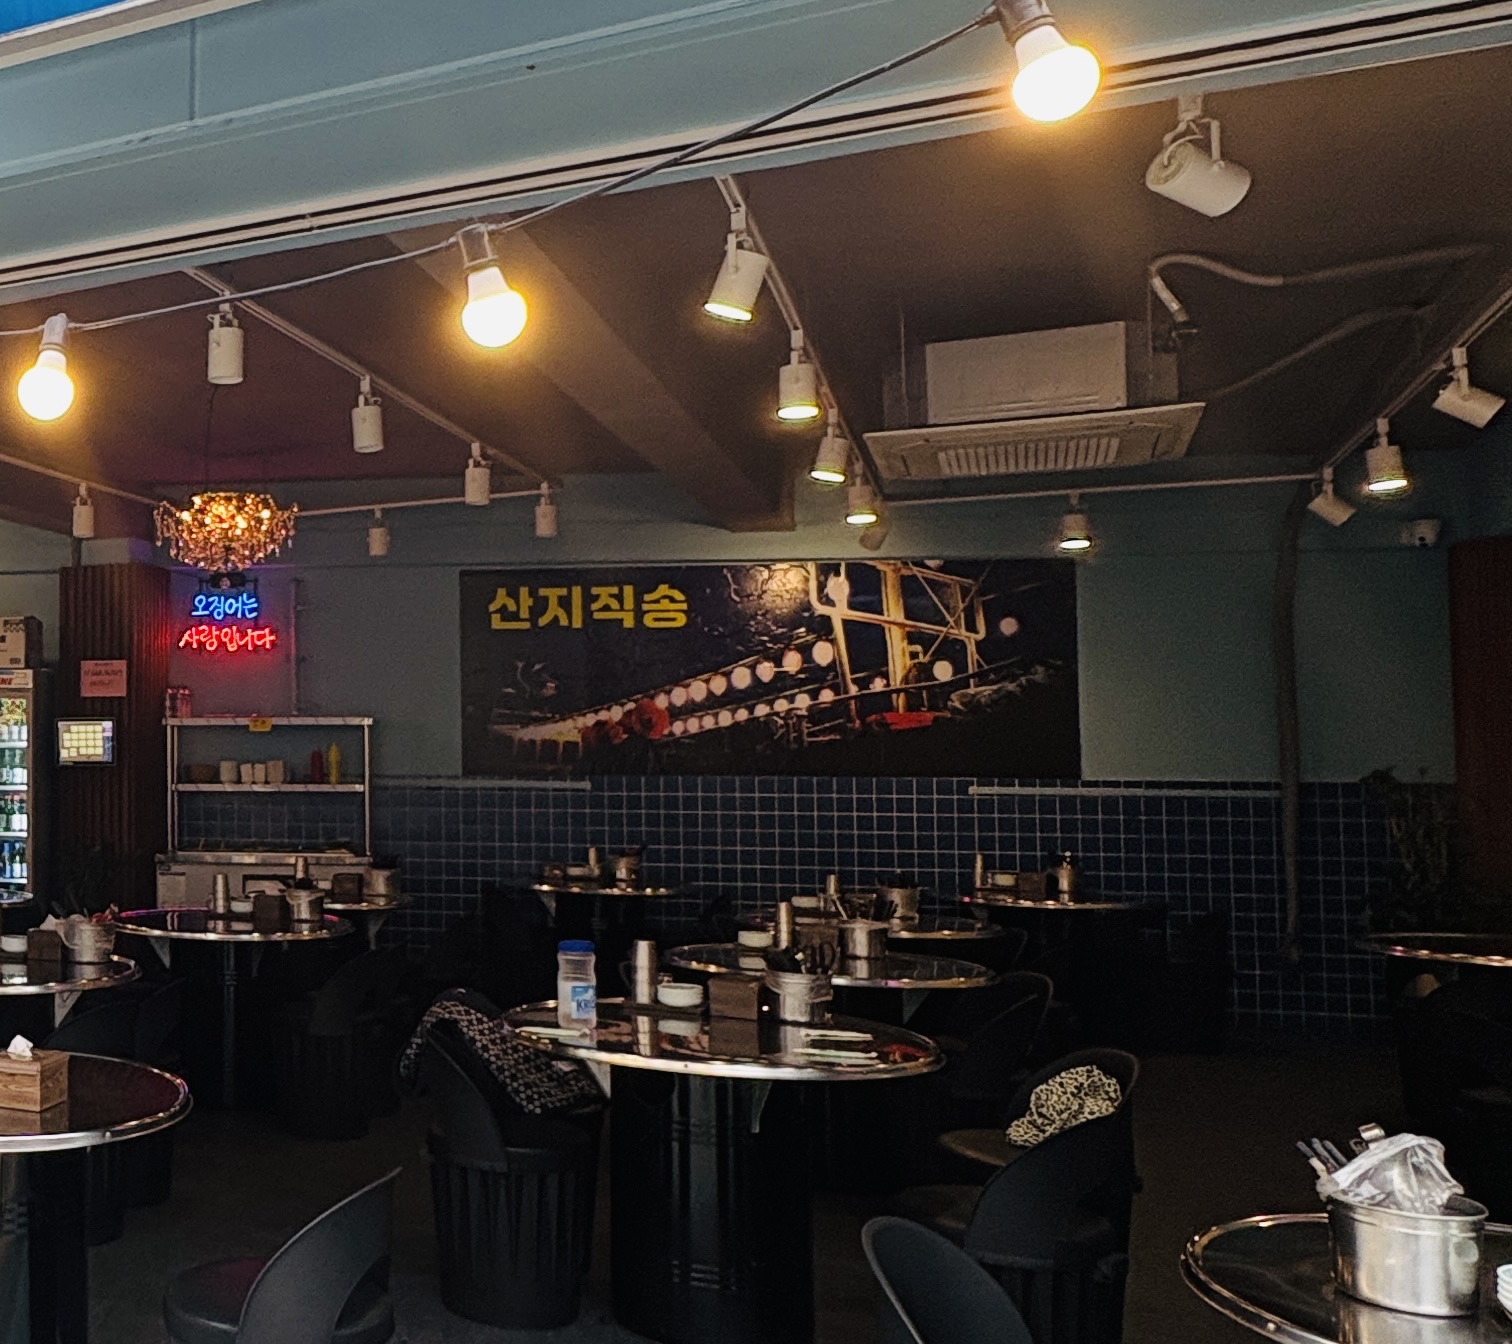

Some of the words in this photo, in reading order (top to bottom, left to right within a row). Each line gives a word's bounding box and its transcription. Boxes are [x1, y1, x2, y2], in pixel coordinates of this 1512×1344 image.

[191, 592, 258, 620] 오징어는
[489, 583, 689, 630] 산지직송
[178, 624, 277, 652] 사랑입니다
